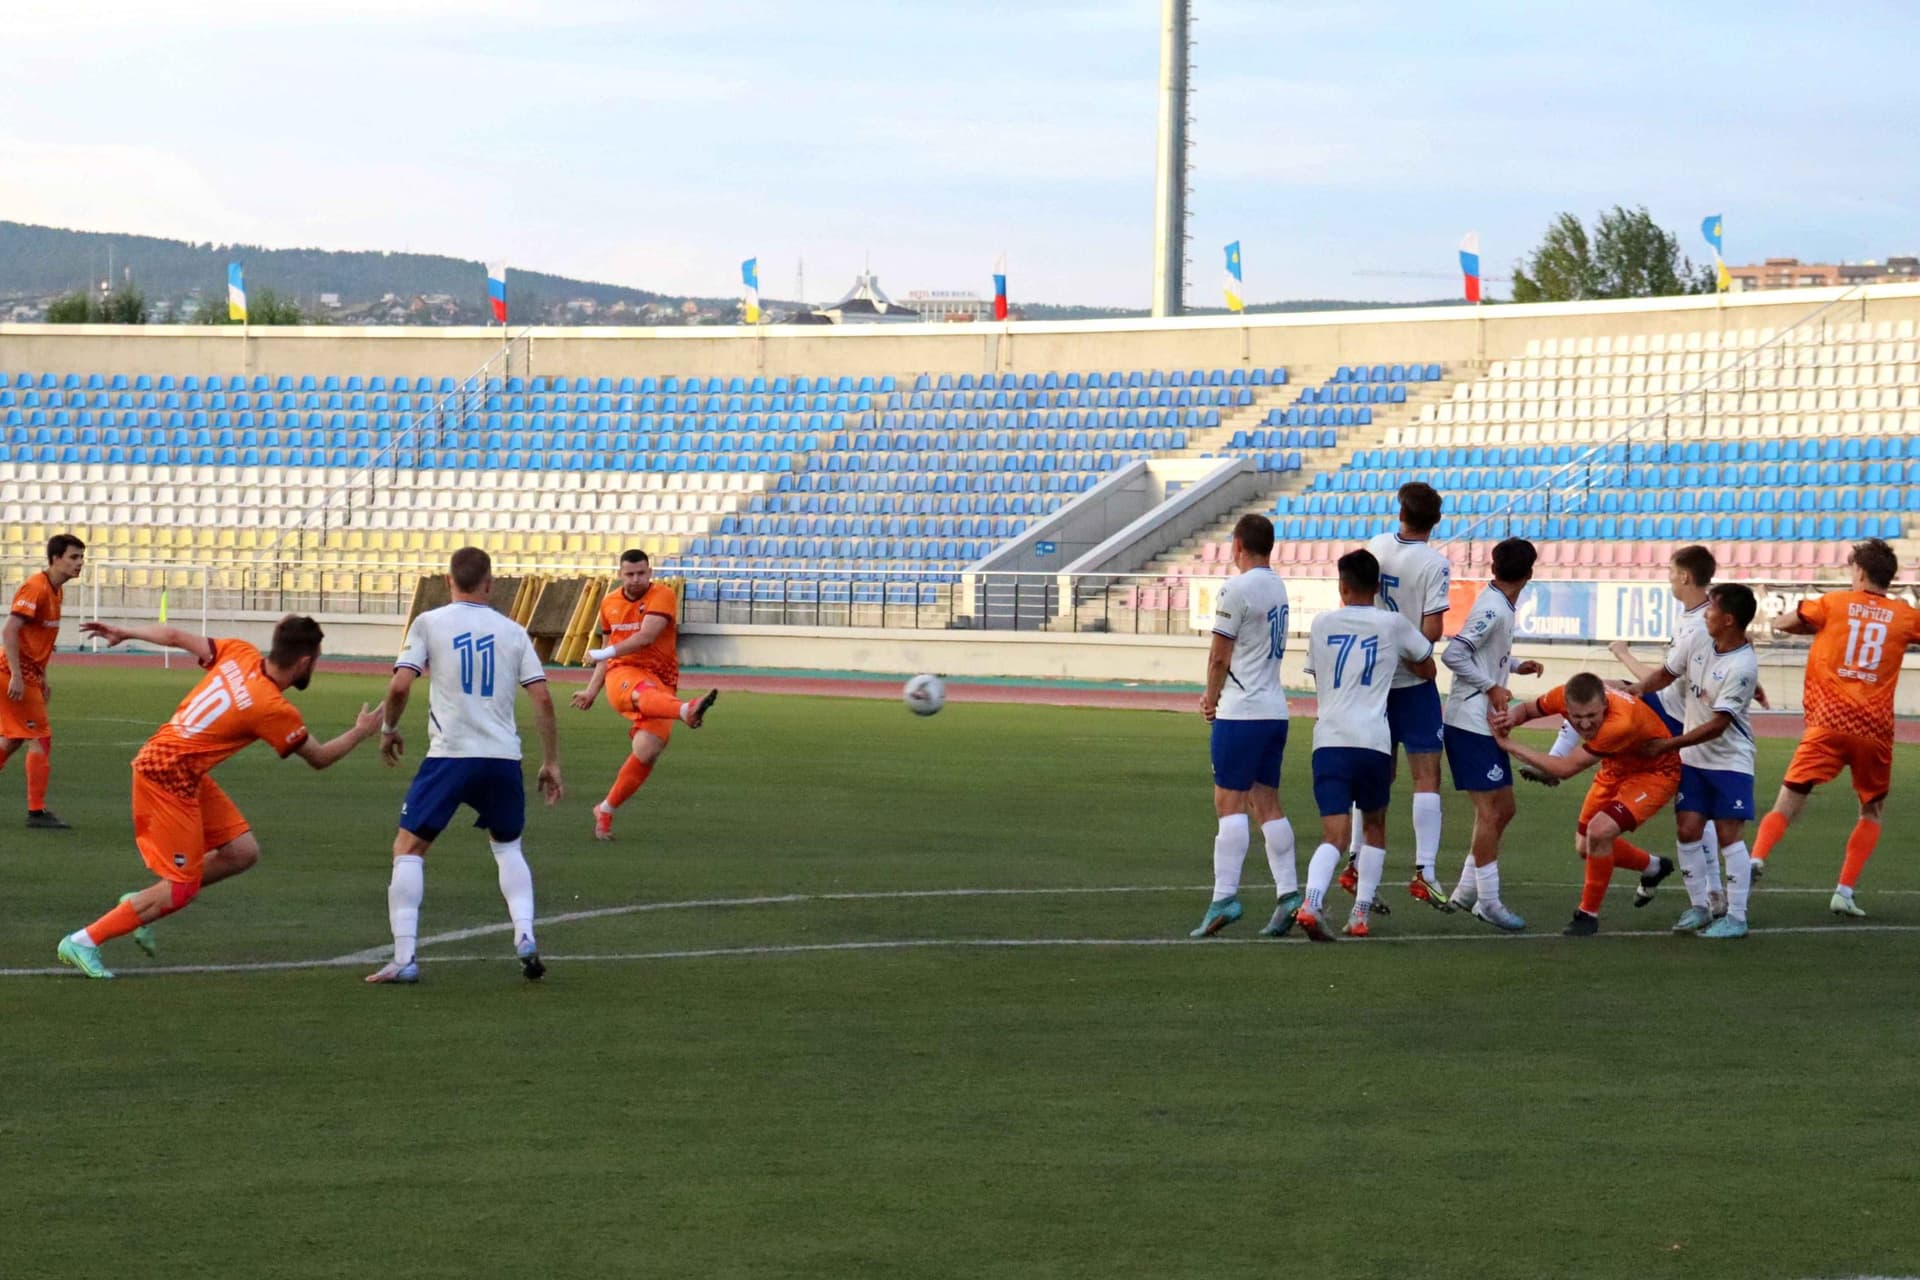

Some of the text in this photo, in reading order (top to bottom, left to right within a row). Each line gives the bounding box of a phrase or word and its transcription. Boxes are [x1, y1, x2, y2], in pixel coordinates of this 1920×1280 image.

[453, 632, 495, 697] 11
[1327, 634, 1379, 689] 71
[1845, 618, 1887, 670] 18
[169, 674, 232, 735] 10
